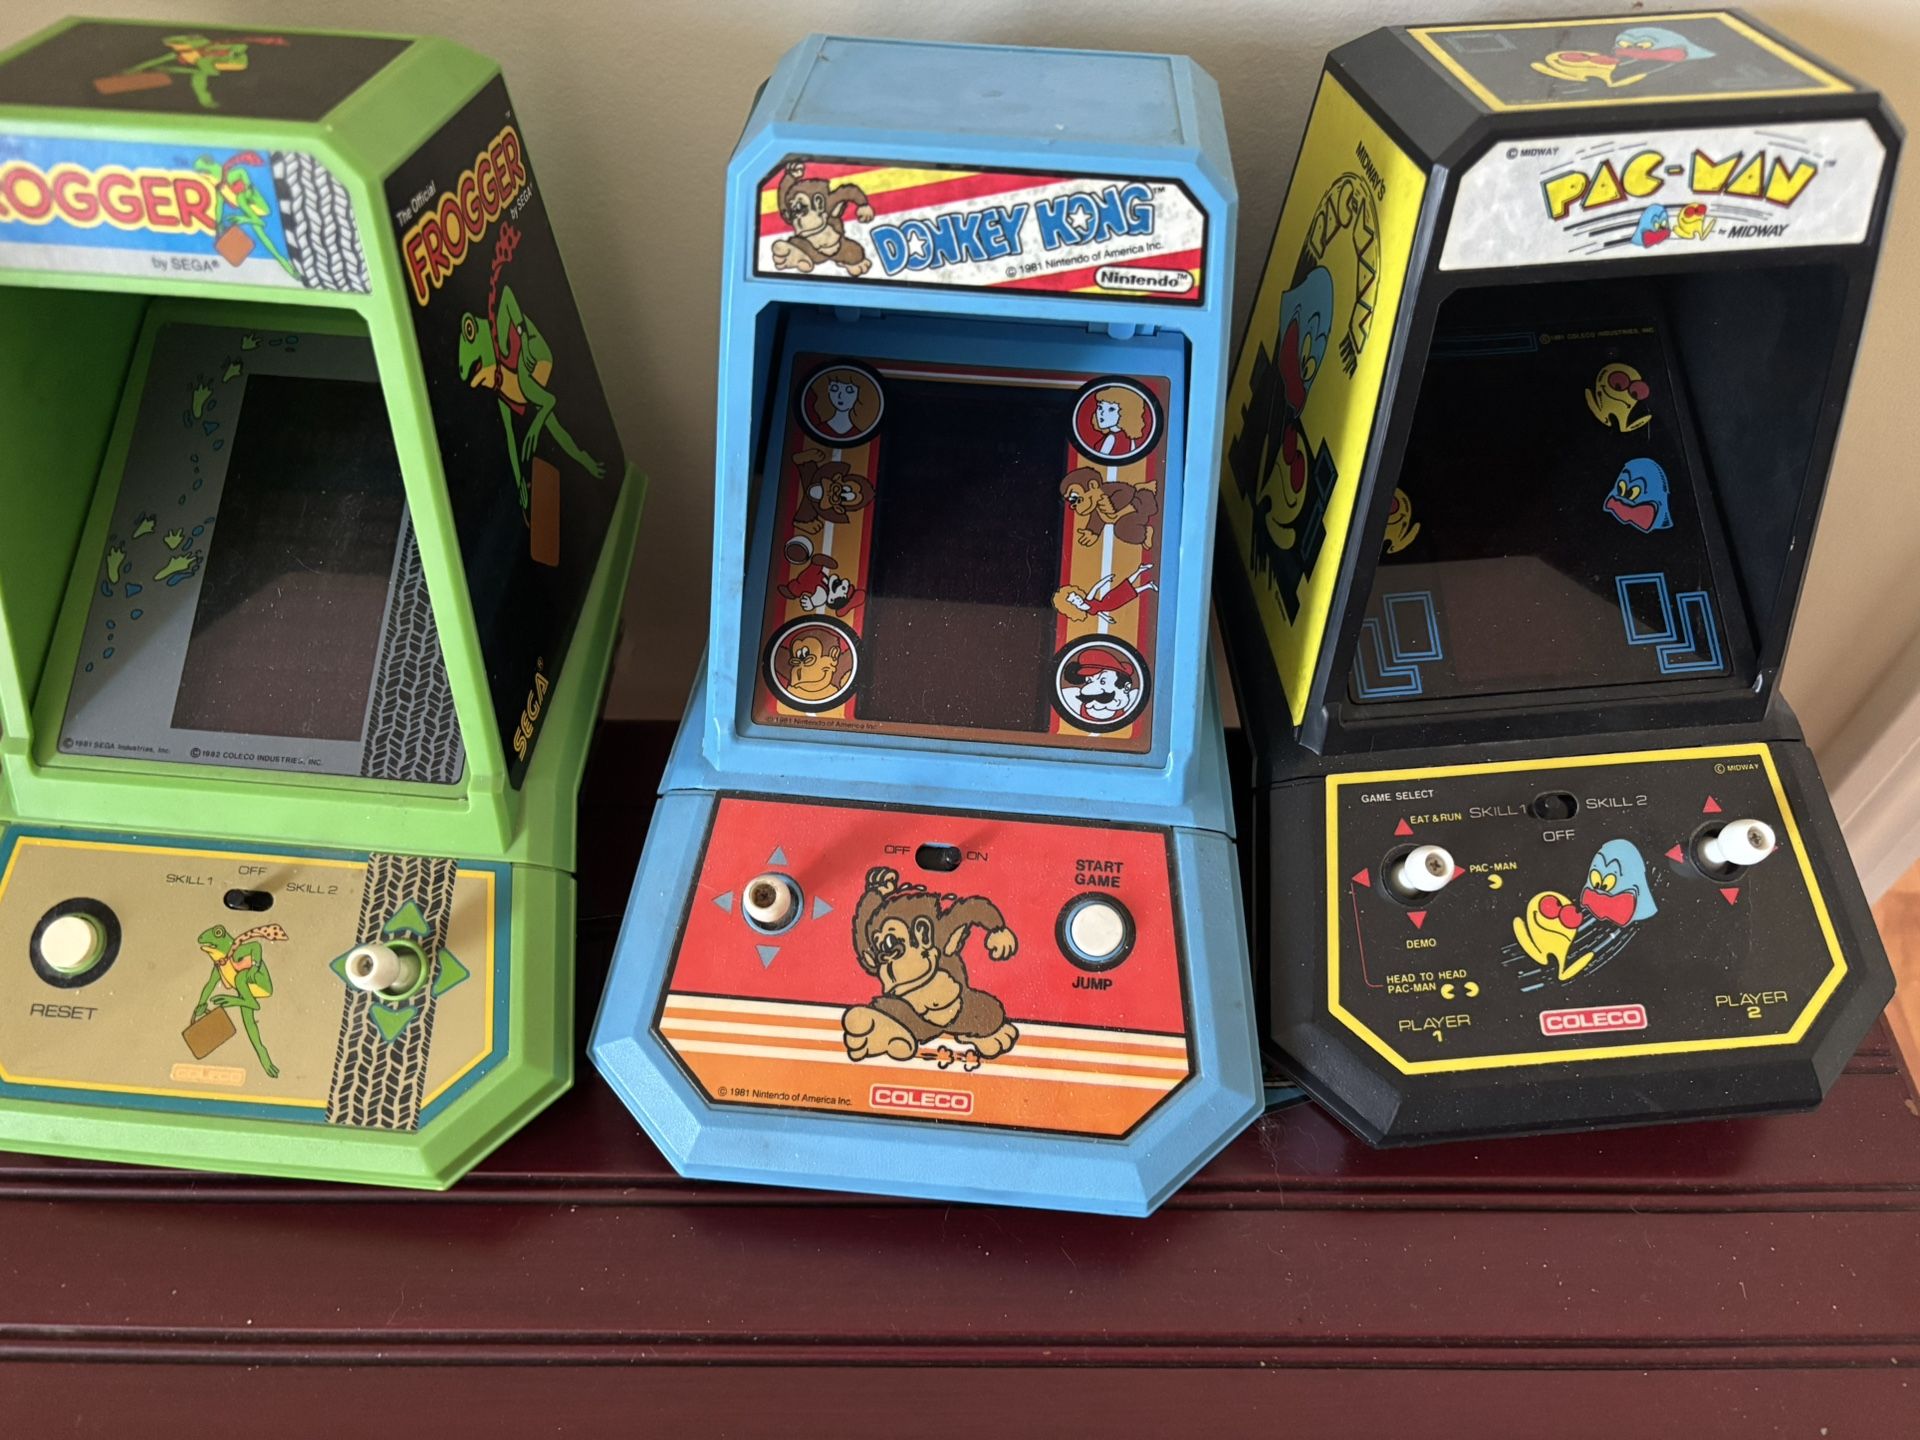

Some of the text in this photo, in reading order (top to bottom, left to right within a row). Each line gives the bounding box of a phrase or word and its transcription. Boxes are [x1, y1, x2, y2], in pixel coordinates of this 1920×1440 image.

[1520, 147, 1560, 157] MIDWAY
[1356, 140, 1386, 201] MIDWAY'S
[1540, 149, 1818, 221] PAC-MAN
[0, 160, 217, 234] OGGER
[396, 179, 437, 227] The Official
[402, 125, 527, 307] FROGGER
[510, 208, 519, 220] by
[870, 202, 1030, 276] DONKEY
[1034, 182, 1155, 251] KONG
[1727, 224, 1789, 239] MIDWAY
[152, 257, 168, 272] by
[1019, 259, 1043, 274] 1981
[1045, 254, 1090, 272] Nintendo
[1091, 251, 1101, 262] of
[1103, 244, 1144, 259] America
[1146, 240, 1164, 251] Inc.
[794, 718, 825, 727] Nintendo
[826, 719, 834, 728] of
[835, 720, 865, 729] America
[93, 741, 115, 750] SEGA
[223, 751, 255, 761] COLECO
[1727, 764, 1759, 772] MIDWAY
[1361, 789, 1434, 804] GAME SELECT
[1585, 795, 1648, 809] SKILL 2
[1410, 814, 1430, 825] EAT
[1440, 812, 1462, 823] RUN
[1469, 803, 1527, 819] SKILL 1
[1543, 829, 1576, 842] OFF
[884, 844, 911, 855] OFF
[966, 849, 988, 862] ON
[238, 865, 268, 876] OFF
[1075, 859, 1124, 874] START
[1469, 862, 1518, 874] PAC-MAN
[166, 873, 205, 886] SKILL
[1074, 873, 1121, 888] GAME
[286, 882, 338, 895] SKILL 2
[1406, 938, 1437, 949] DEMO
[1072, 976, 1112, 991] JUMP
[1386, 969, 1467, 984] HEAD TO HEAD
[1387, 981, 1437, 994] PAC-MAN
[1715, 990, 1788, 1007] PLAYER
[30, 1003, 98, 1020] RESET
[1747, 1006, 1762, 1019] 2
[1398, 1014, 1471, 1032] PLAYER
[1546, 1009, 1642, 1031] COLECO
[1432, 1030, 1443, 1042] 1
[730, 1087, 750, 1097] 1981
[752, 1089, 791, 1101] Nintendo
[791, 1092, 801, 1102] of
[801, 1093, 837, 1105] America
[837, 1096, 853, 1106] Inc.
[874, 1088, 969, 1110] COLECO
